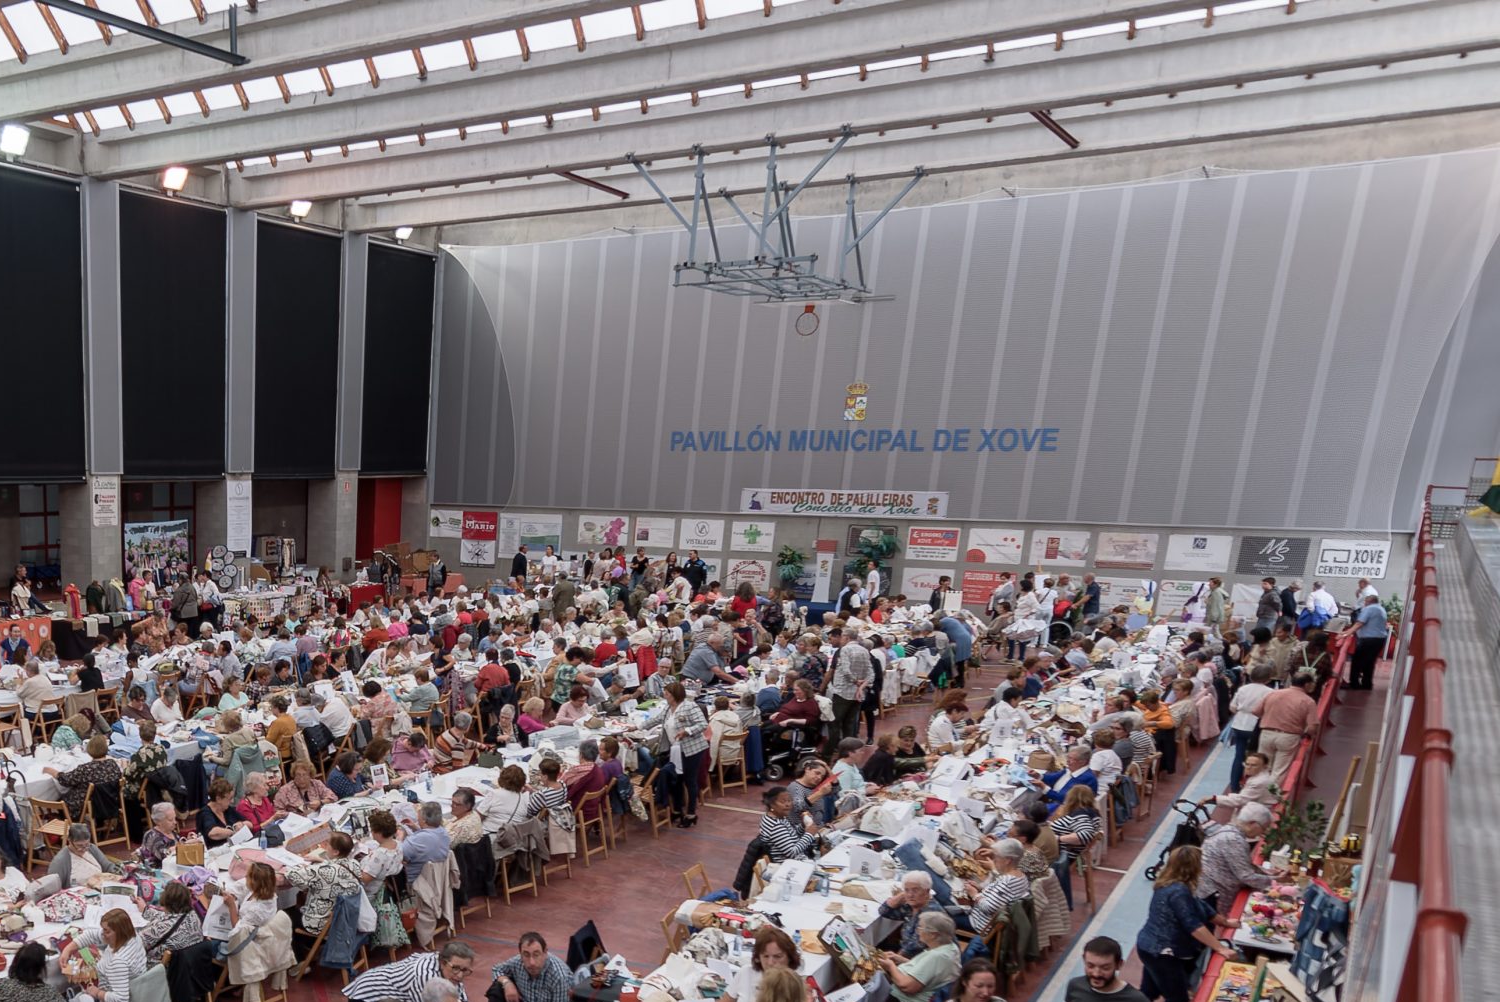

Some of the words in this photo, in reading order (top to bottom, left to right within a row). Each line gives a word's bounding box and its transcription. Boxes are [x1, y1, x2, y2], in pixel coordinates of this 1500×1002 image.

[669, 424, 782, 452] PAVILLÓN
[787, 428, 925, 452] MUNICIPAL
[932, 428, 971, 452] DE
[976, 427, 1061, 452] XOVE
[770, 491, 826, 505] ENCONTRO
[830, 492, 846, 505] DE
[846, 493, 914, 507] PALILLEIRAS
[858, 504, 876, 514] de
[465, 519, 496, 530] MARIO
[1353, 549, 1384, 564] XOVE
[1318, 565, 1349, 575] CENTRO
